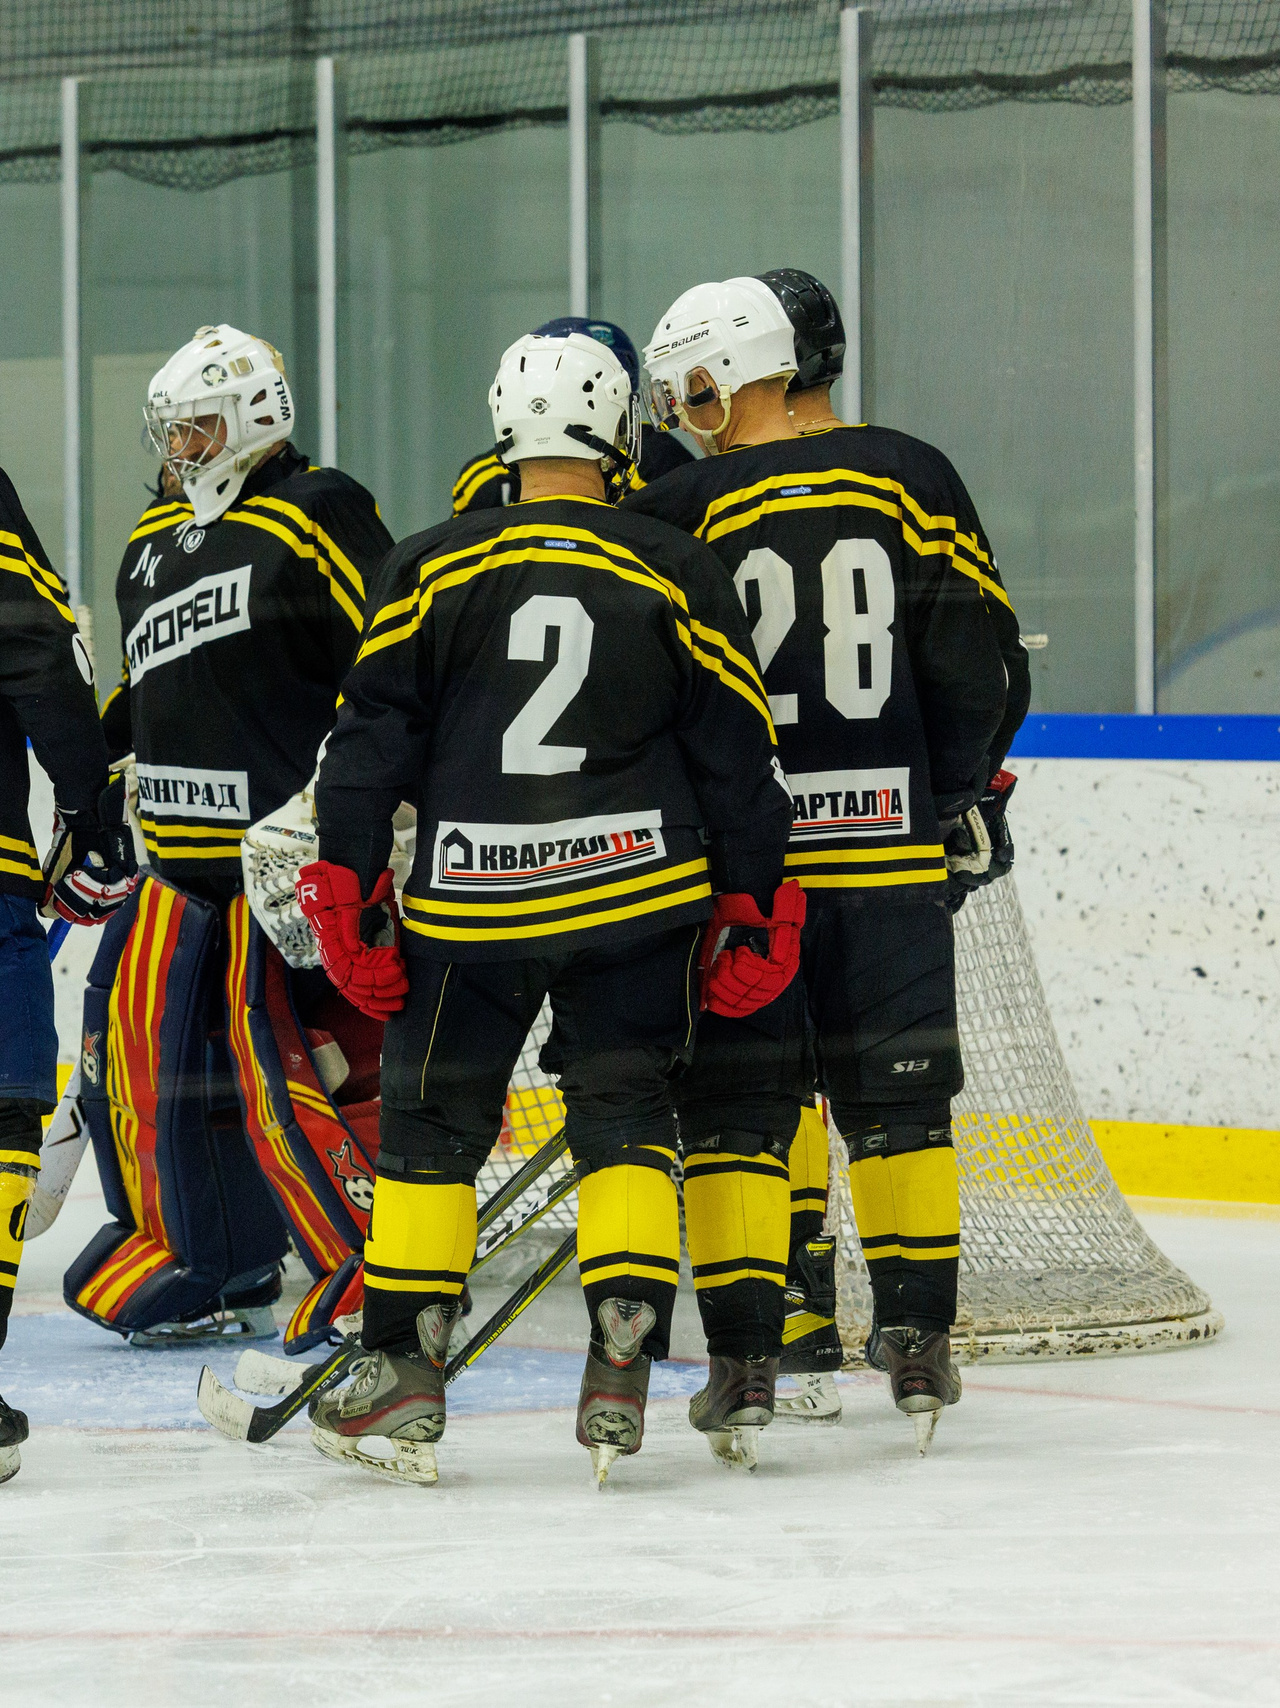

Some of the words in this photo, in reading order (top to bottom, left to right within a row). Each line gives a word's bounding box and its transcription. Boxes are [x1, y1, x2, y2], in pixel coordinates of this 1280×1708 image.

[670, 329, 710, 350] BAUER
[733, 538, 896, 726] 28
[501, 594, 595, 776] 2
[793, 788, 904, 820] АРТАЛ17А
[476, 1188, 549, 1259] CM
